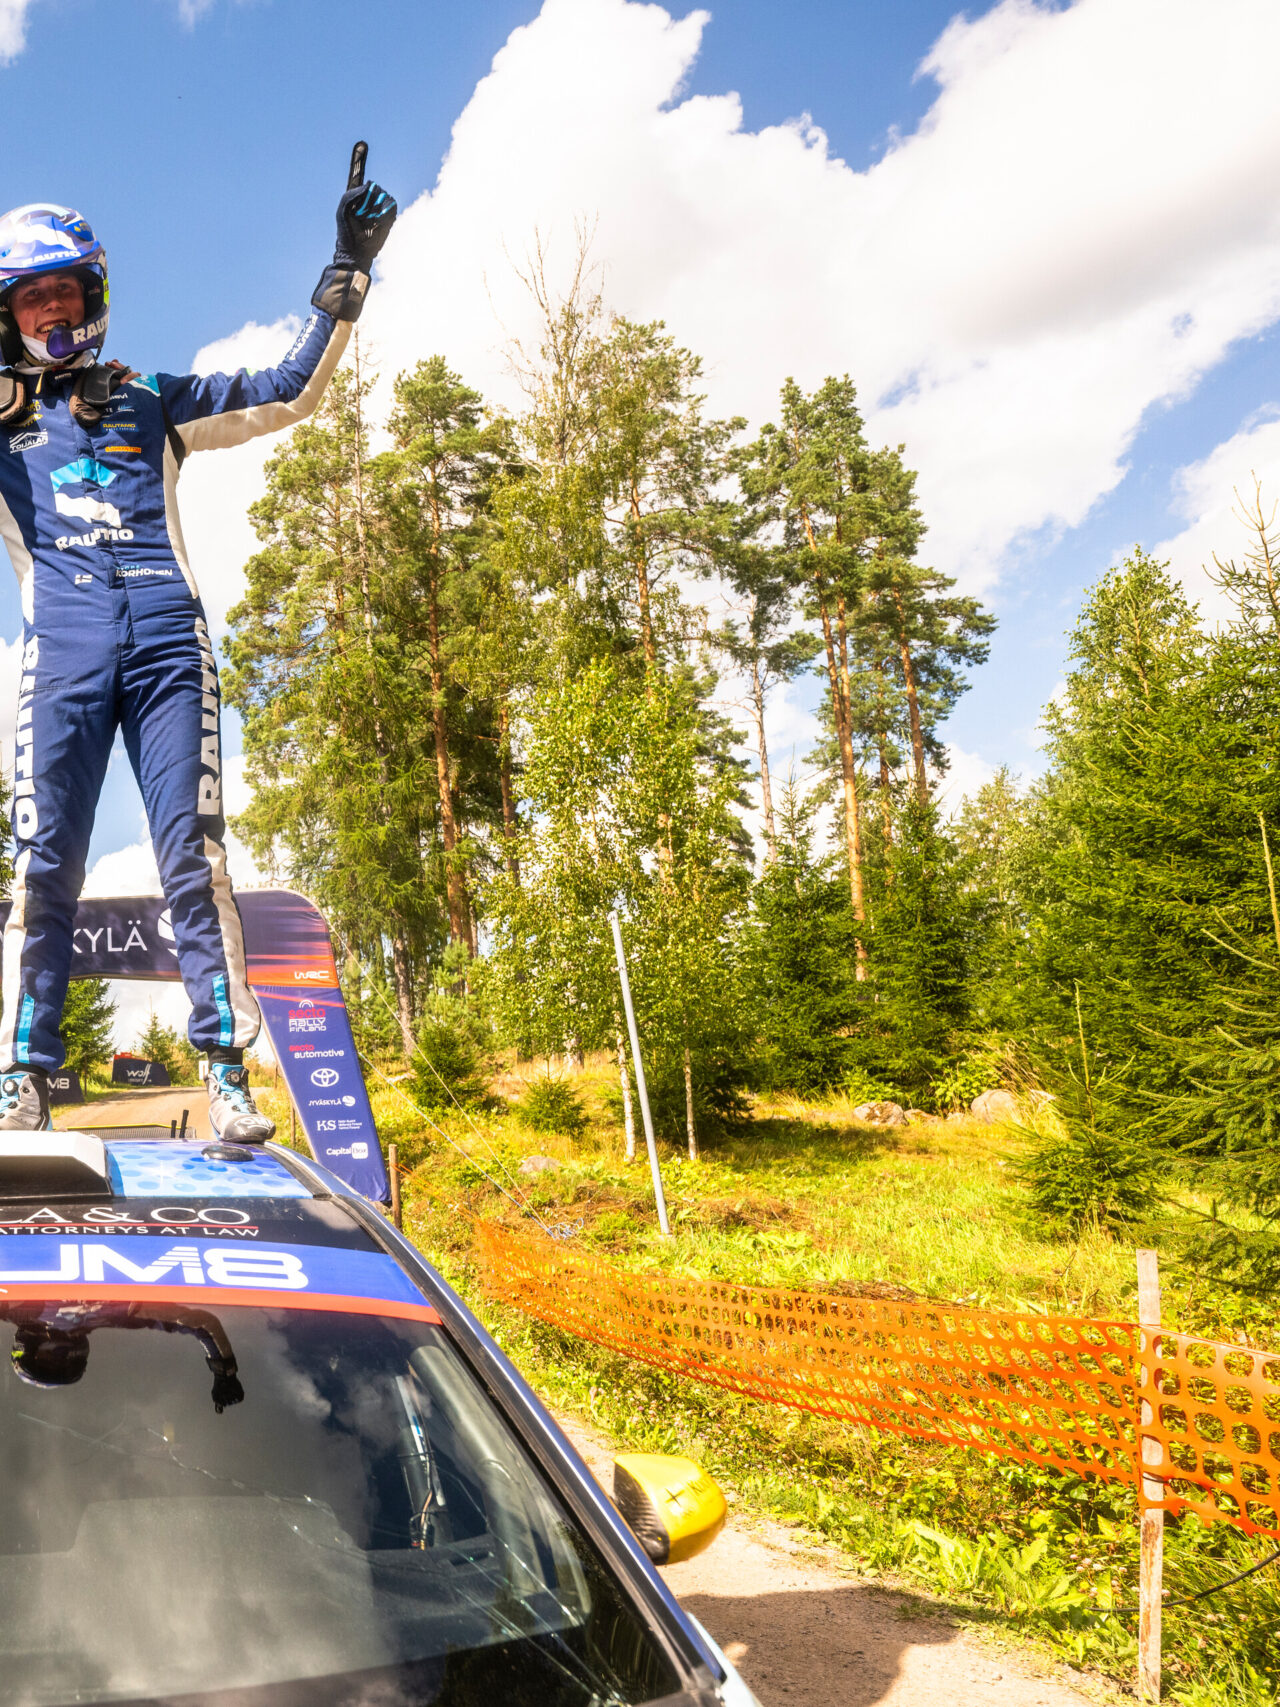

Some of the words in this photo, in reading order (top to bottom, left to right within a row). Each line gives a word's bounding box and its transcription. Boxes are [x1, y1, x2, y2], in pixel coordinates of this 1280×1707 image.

[55, 528, 134, 552] RAUTIO
[288, 1007, 326, 1019] secto
[294, 1049, 345, 1059] automotive
[317, 1120, 337, 1131] KS
[83, 1207, 144, 1223] &
[150, 1207, 251, 1225] CO
[160, 1226, 190, 1235] AT
[203, 1227, 259, 1237] LAW
